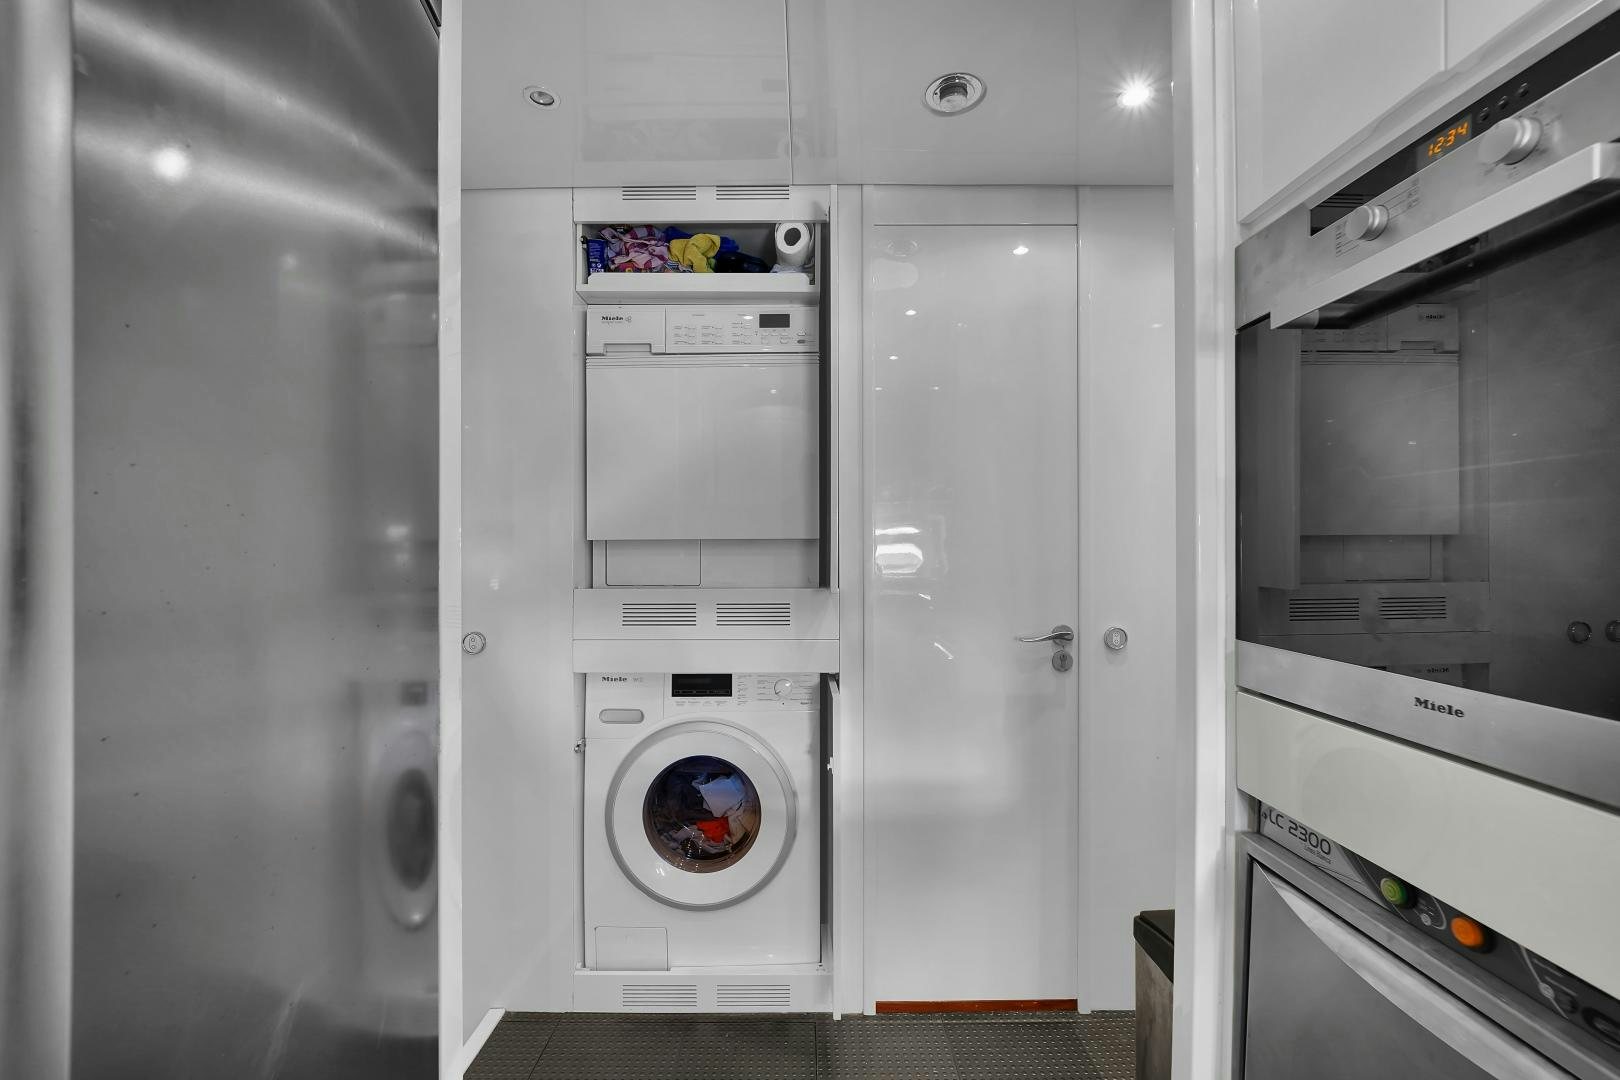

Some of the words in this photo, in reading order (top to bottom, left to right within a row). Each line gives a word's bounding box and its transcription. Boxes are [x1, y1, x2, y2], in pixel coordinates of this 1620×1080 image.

[1414, 696, 1465, 718] Miele
[1269, 809, 1284, 829] LC
[1288, 819, 1332, 856] 2300
